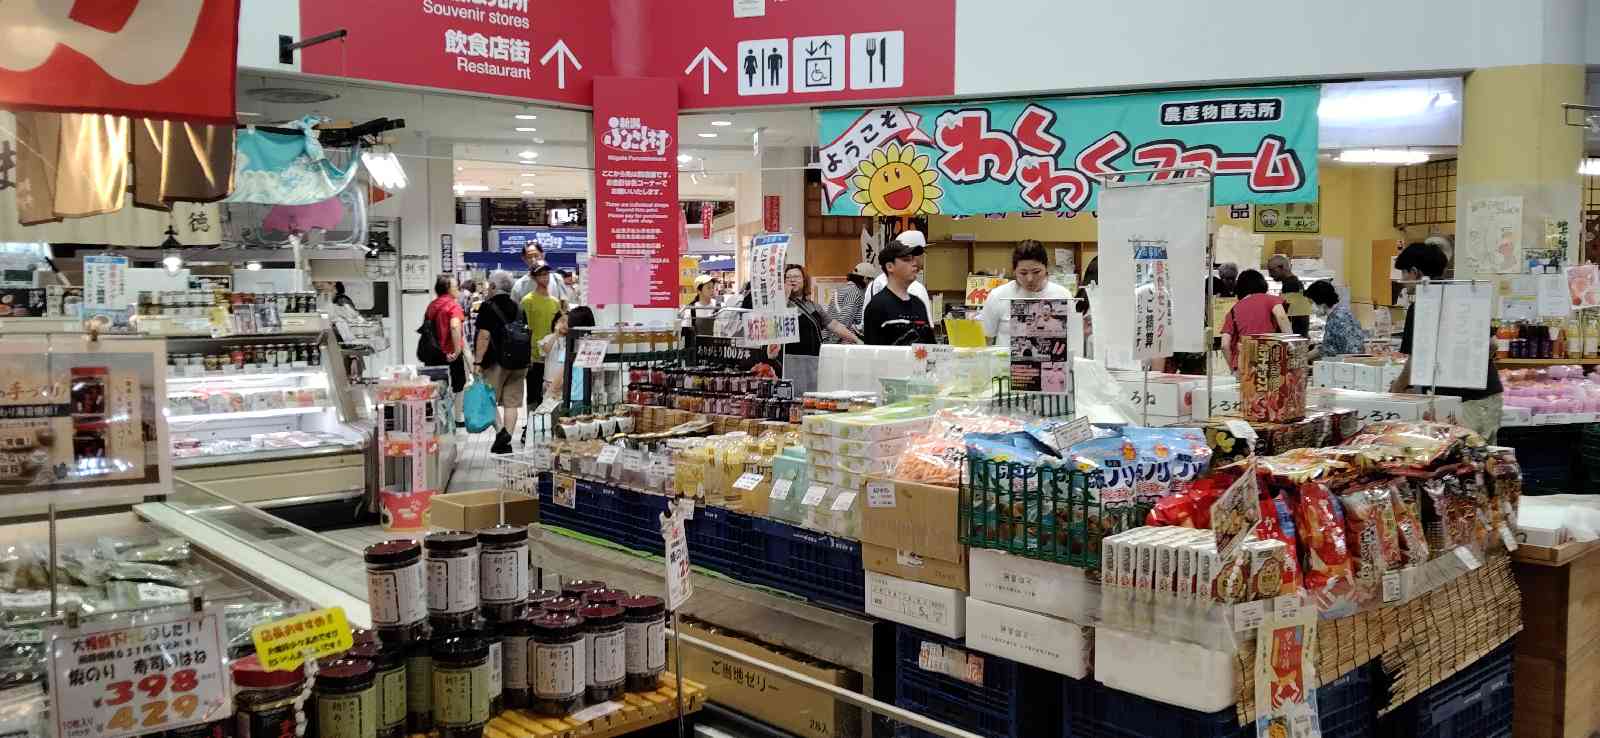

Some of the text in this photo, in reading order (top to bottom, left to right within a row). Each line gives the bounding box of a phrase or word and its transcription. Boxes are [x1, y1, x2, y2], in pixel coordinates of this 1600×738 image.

[424, 2, 530, 29] Souvenir stores
[445, 29, 531, 65] 飲食店街
[457, 57, 531, 80] Restaurant
[1164, 101, 1277, 122] 農産物直売所
[824, 109, 898, 173] ようこそ
[188, 211, 210, 233] 徳
[711, 659, 780, 693] ご当地ゼリー
